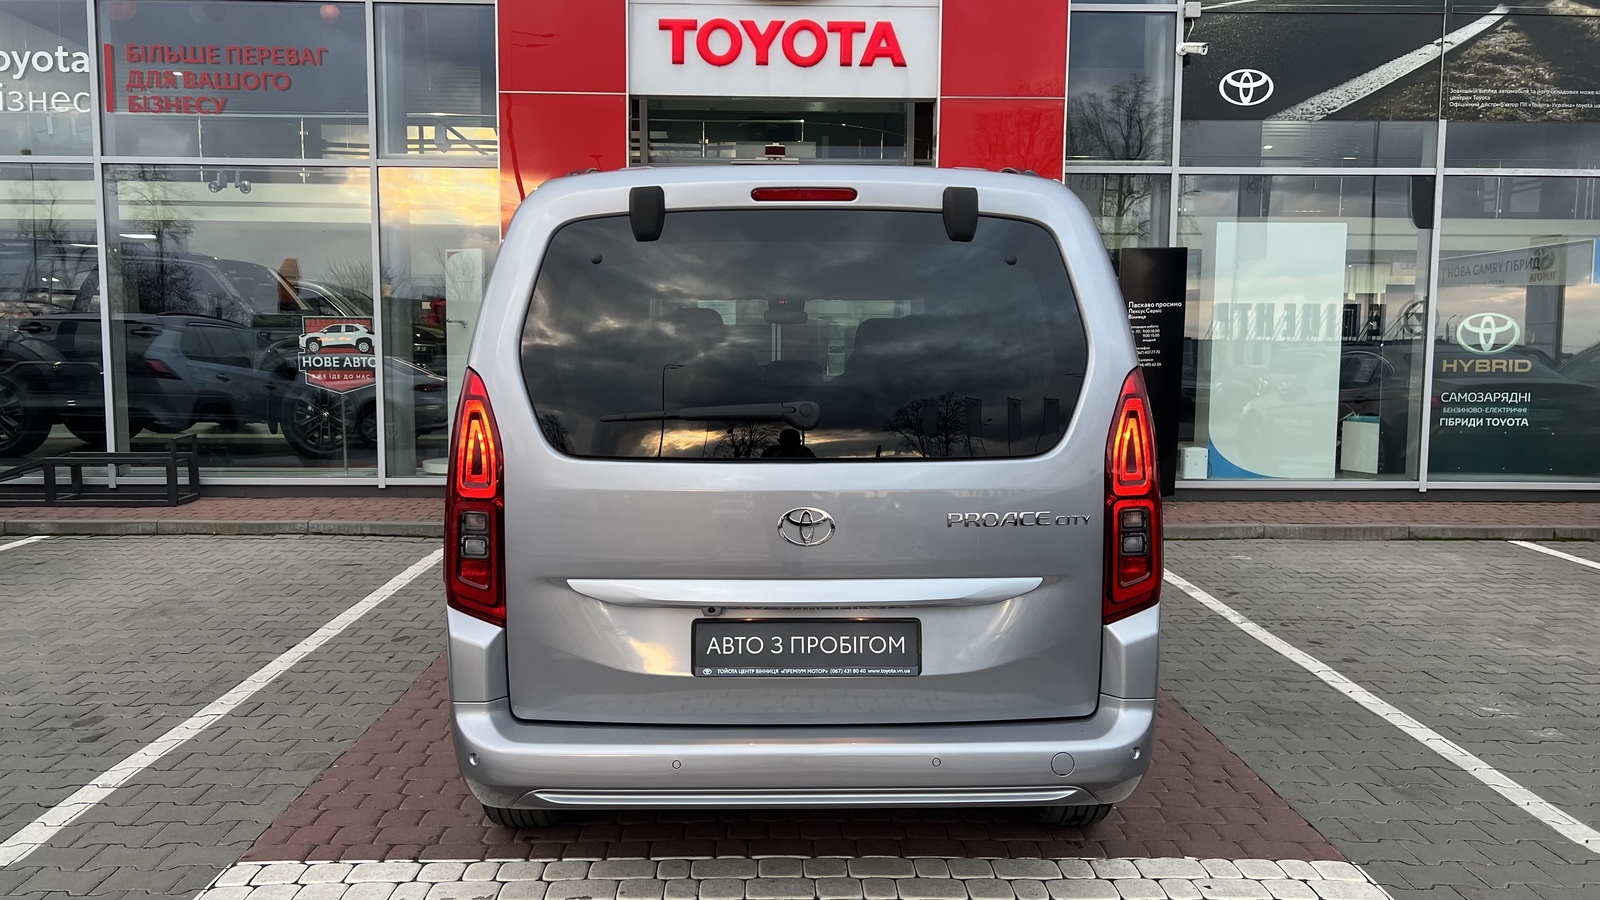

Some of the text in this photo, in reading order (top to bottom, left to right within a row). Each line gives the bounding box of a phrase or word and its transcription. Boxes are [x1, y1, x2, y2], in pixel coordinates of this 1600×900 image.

[658, 18, 907, 67] TOYOTA
[125, 43, 328, 66] БІЛЬШЕ ПЕРЕВАГ
[126, 69, 291, 91] ДЛЯ ВАШОГО
[128, 95, 228, 114] БІЗНЕСУ
[1447, 256, 1541, 278] НОВА CAMRY ГІБРИД
[302, 356, 376, 368] НОВЕ АВТО
[1442, 359, 1533, 373] HYBRID
[1440, 392, 1531, 404] САМОЗАРЯДНІ
[1442, 406, 1528, 414] БЕНЗИНОВО-ЕЛЕКТРИЧНІ
[1439, 418, 1529, 427] ГІБРИДИ TOYOTA
[947, 511, 1092, 528] PROACE CITY
[706, 636, 764, 655] АВТО
[790, 635, 905, 655] ПРОБІГОМ
